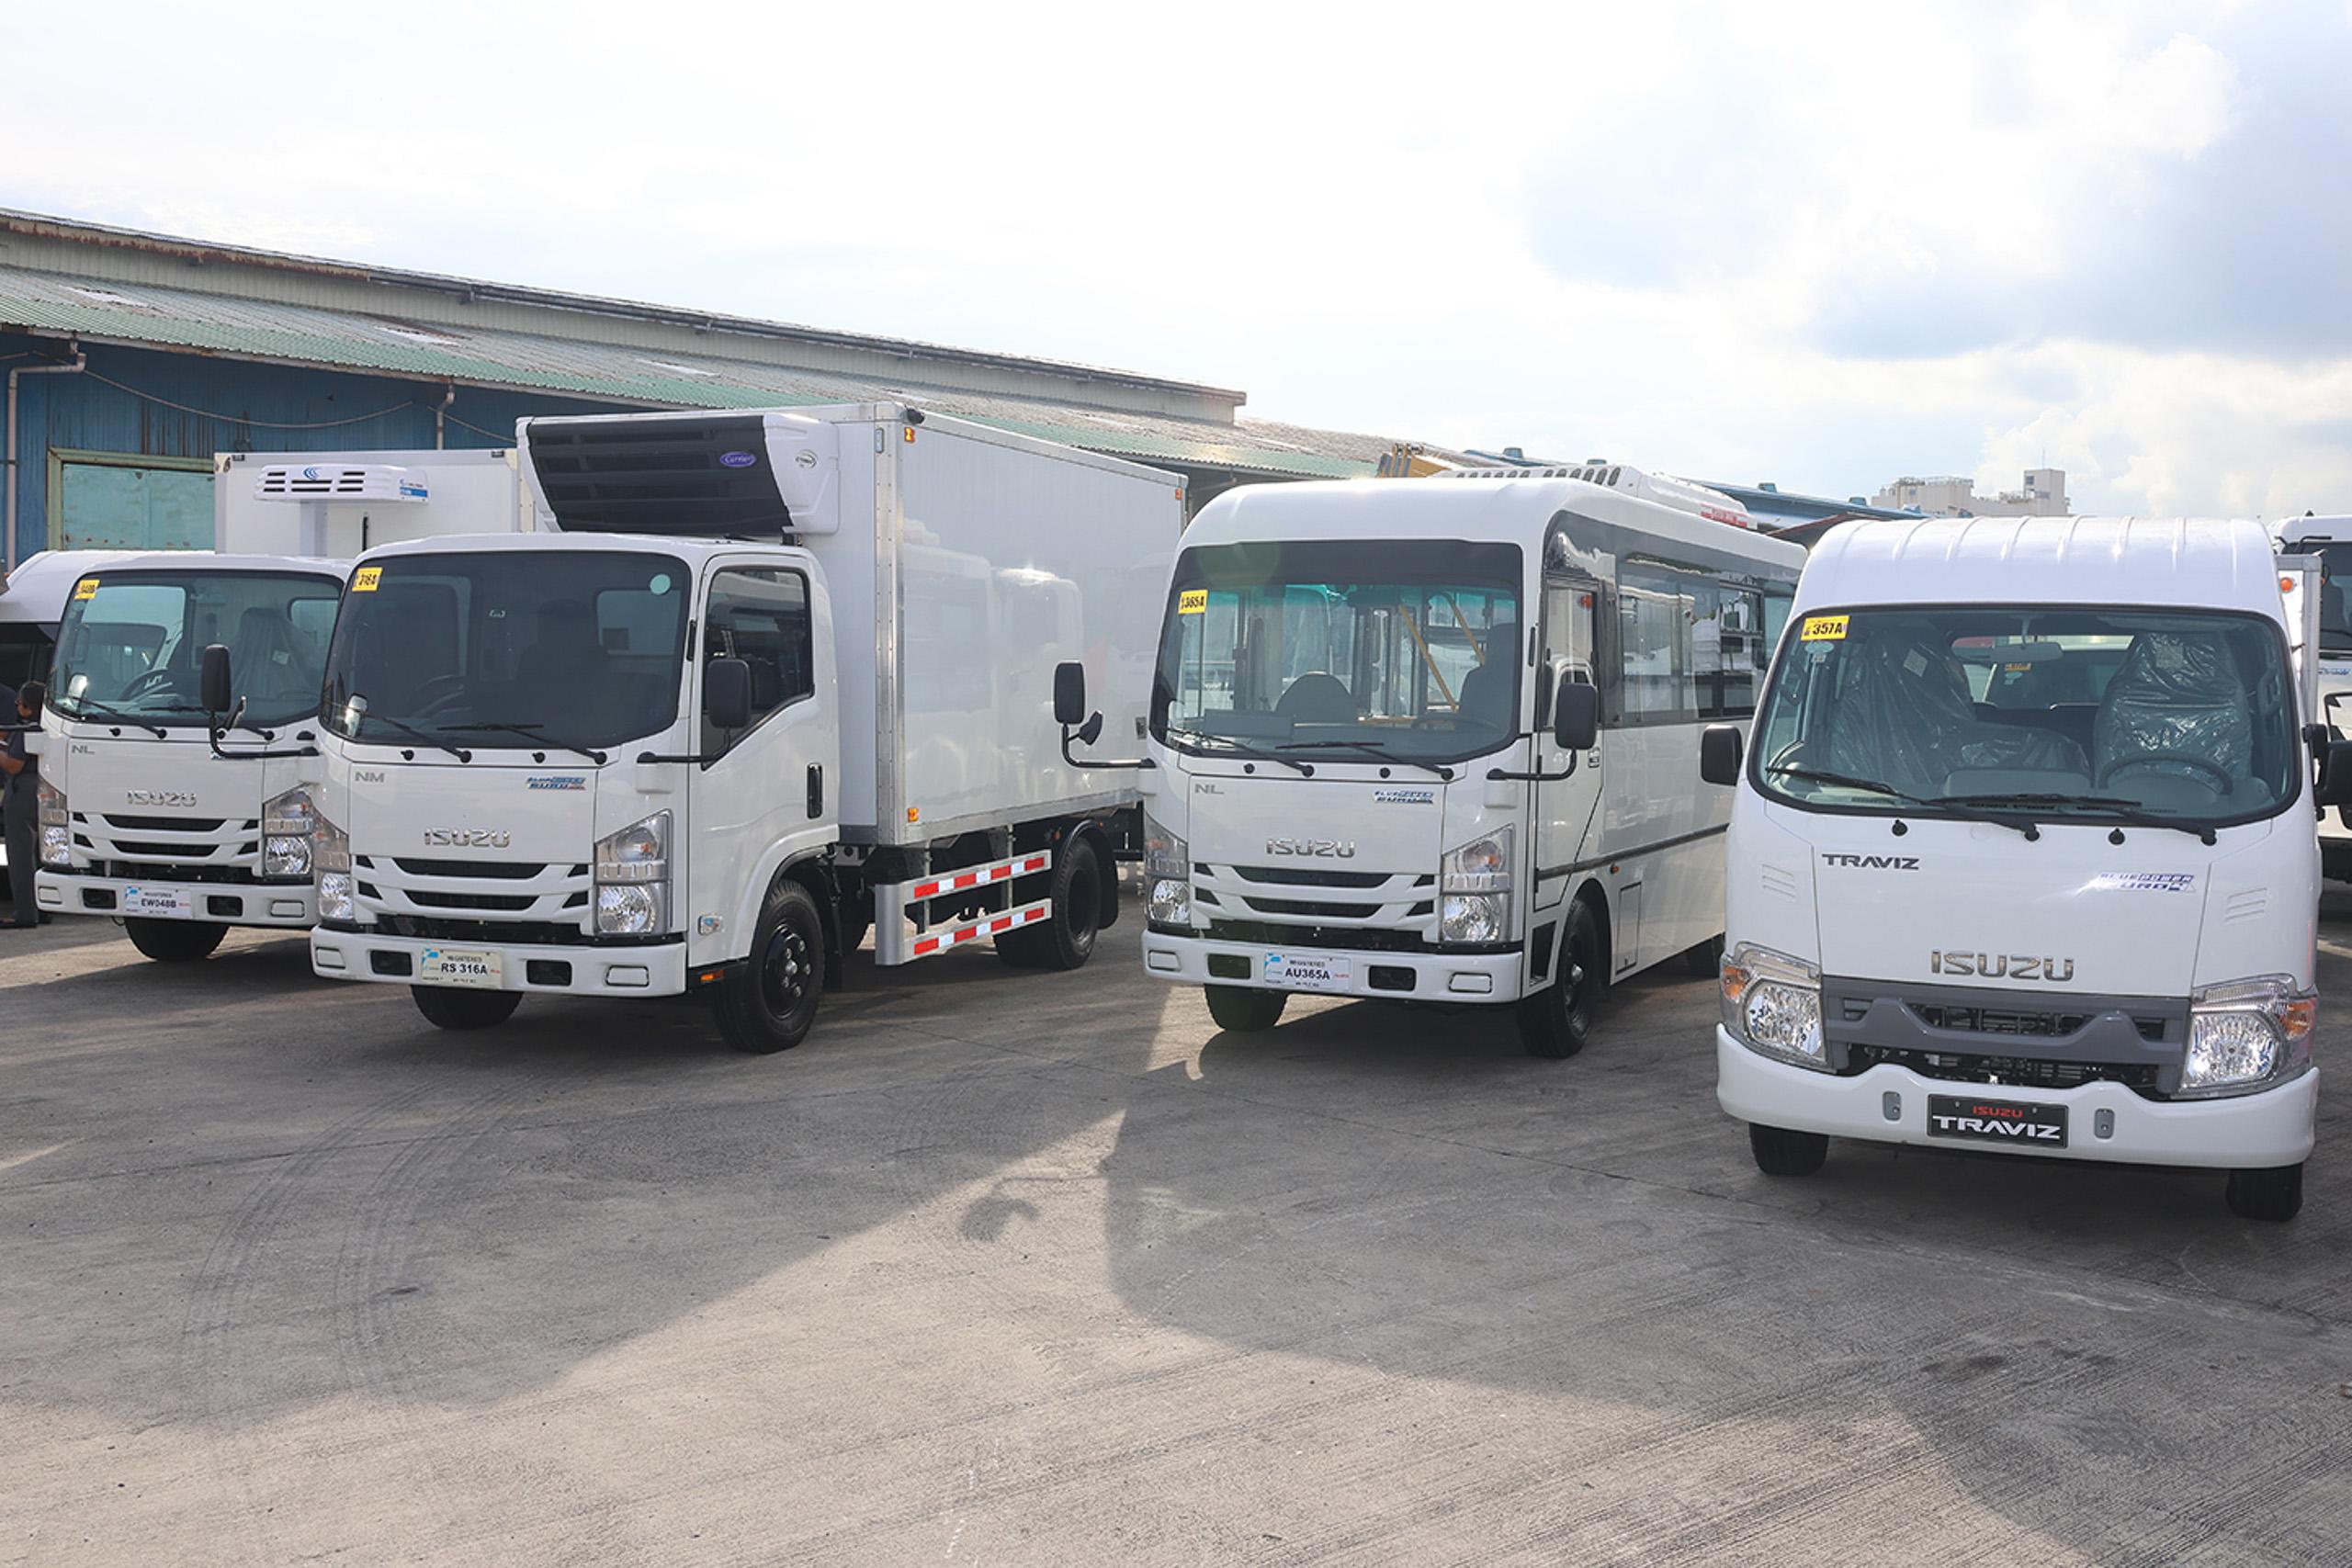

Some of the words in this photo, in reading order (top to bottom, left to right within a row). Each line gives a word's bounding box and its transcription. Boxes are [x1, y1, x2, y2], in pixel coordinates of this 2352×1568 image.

[1813, 622, 1843, 635] 357A
[72, 745, 95, 754] NL
[355, 772, 384, 783] NM
[1194, 784, 1224, 795] NL
[127, 790, 198, 807] ISUZU
[424, 828, 511, 848] ISUZU
[1266, 838, 1355, 858] ISUZU
[1822, 853, 1920, 870] TRAVIZ
[441, 963, 457, 973] RS
[459, 964, 488, 975] 316A
[1931, 950, 2074, 982] ISUZU
[1285, 967, 1330, 980] AU365A
[1973, 1106, 2023, 1118] ISUZU
[1932, 1115, 2061, 1139] TRAVIZ
